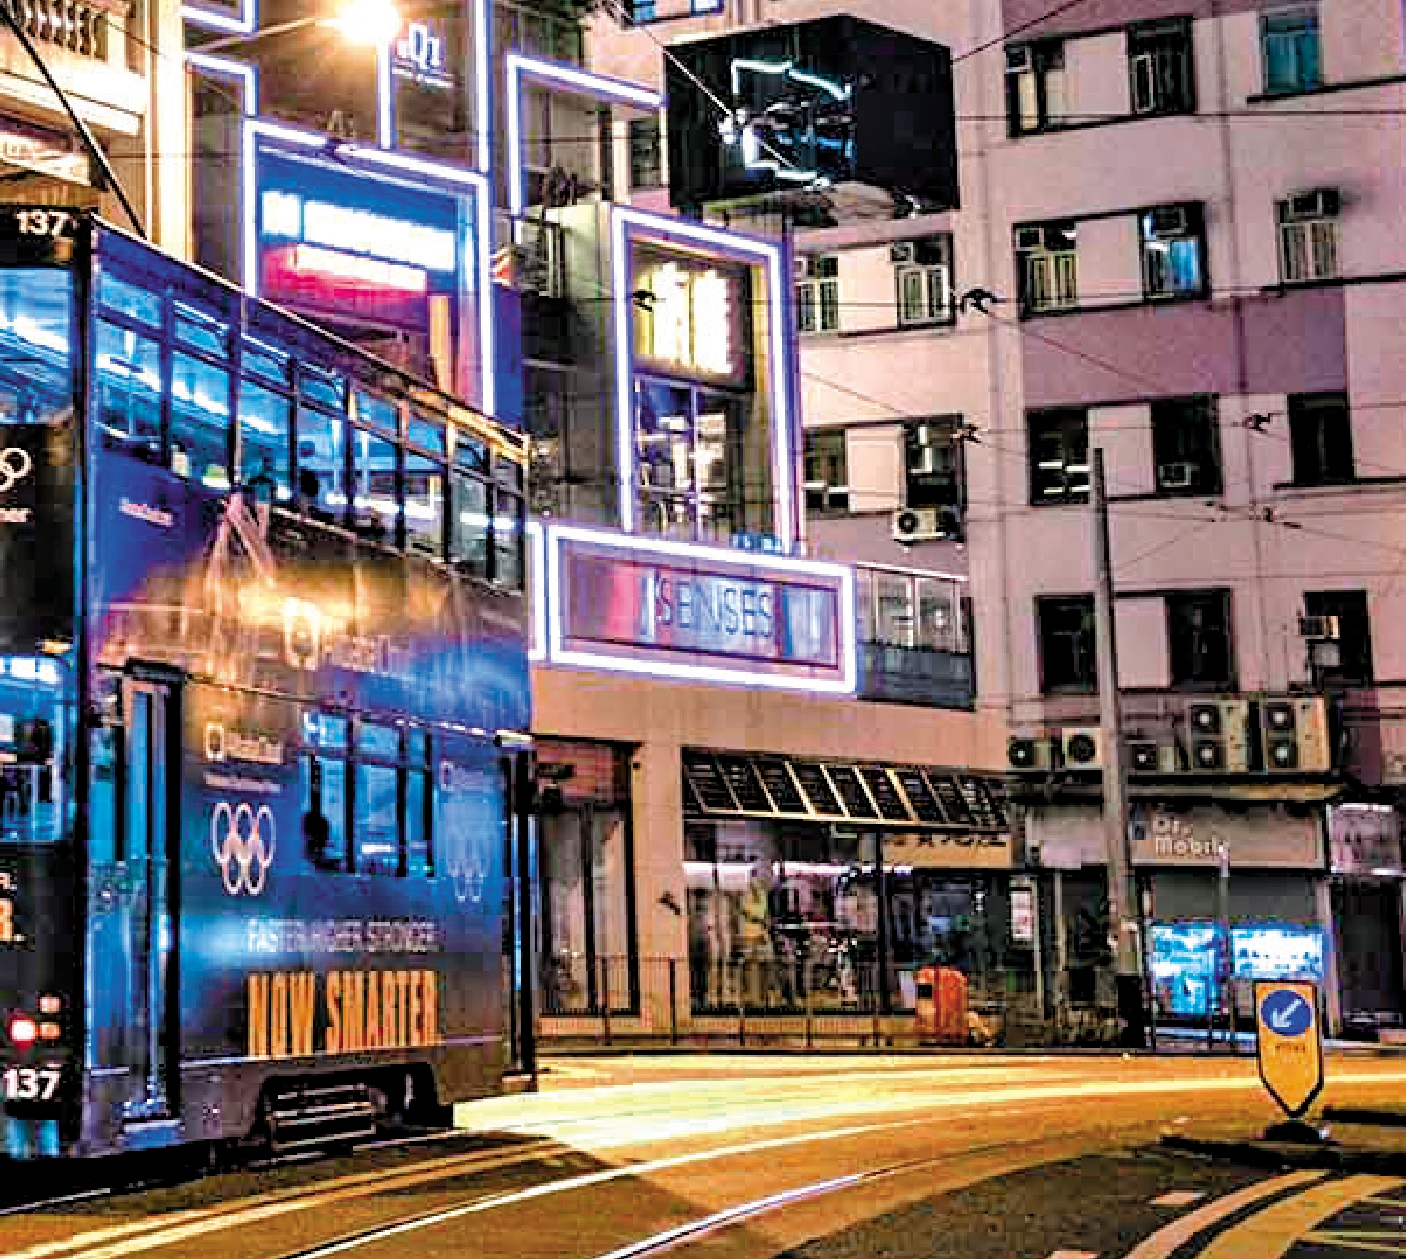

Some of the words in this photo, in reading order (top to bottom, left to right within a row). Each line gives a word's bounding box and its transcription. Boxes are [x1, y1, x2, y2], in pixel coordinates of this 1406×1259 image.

[18, 209, 71, 237] 137
[248, 971, 315, 1061] NOW
[3, 1066, 62, 1100] 137
